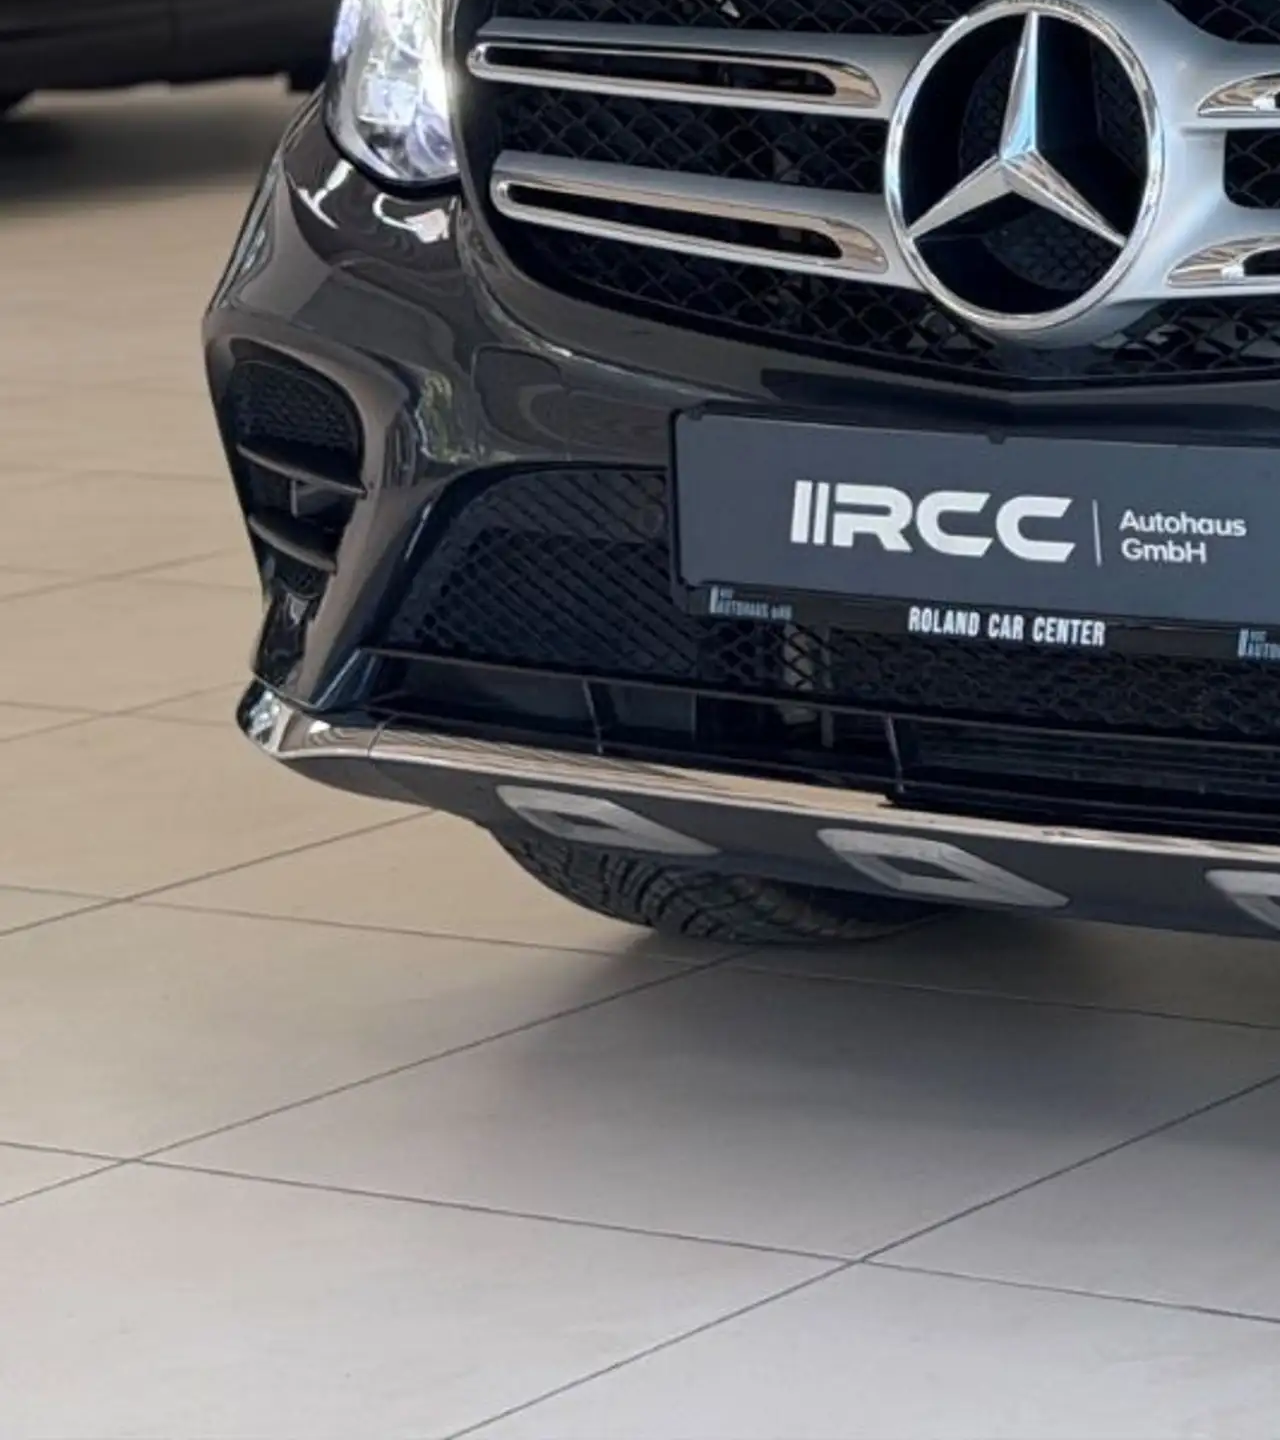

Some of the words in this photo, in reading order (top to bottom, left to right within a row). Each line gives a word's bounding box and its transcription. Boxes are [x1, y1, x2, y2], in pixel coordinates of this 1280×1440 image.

[1119, 509, 1247, 538] Autohaus
[1121, 538, 1207, 564] GmbH
[908, 605, 978, 637] ROLAND
[988, 612, 1024, 641] CAR
[1032, 615, 1106, 647] CENTER
